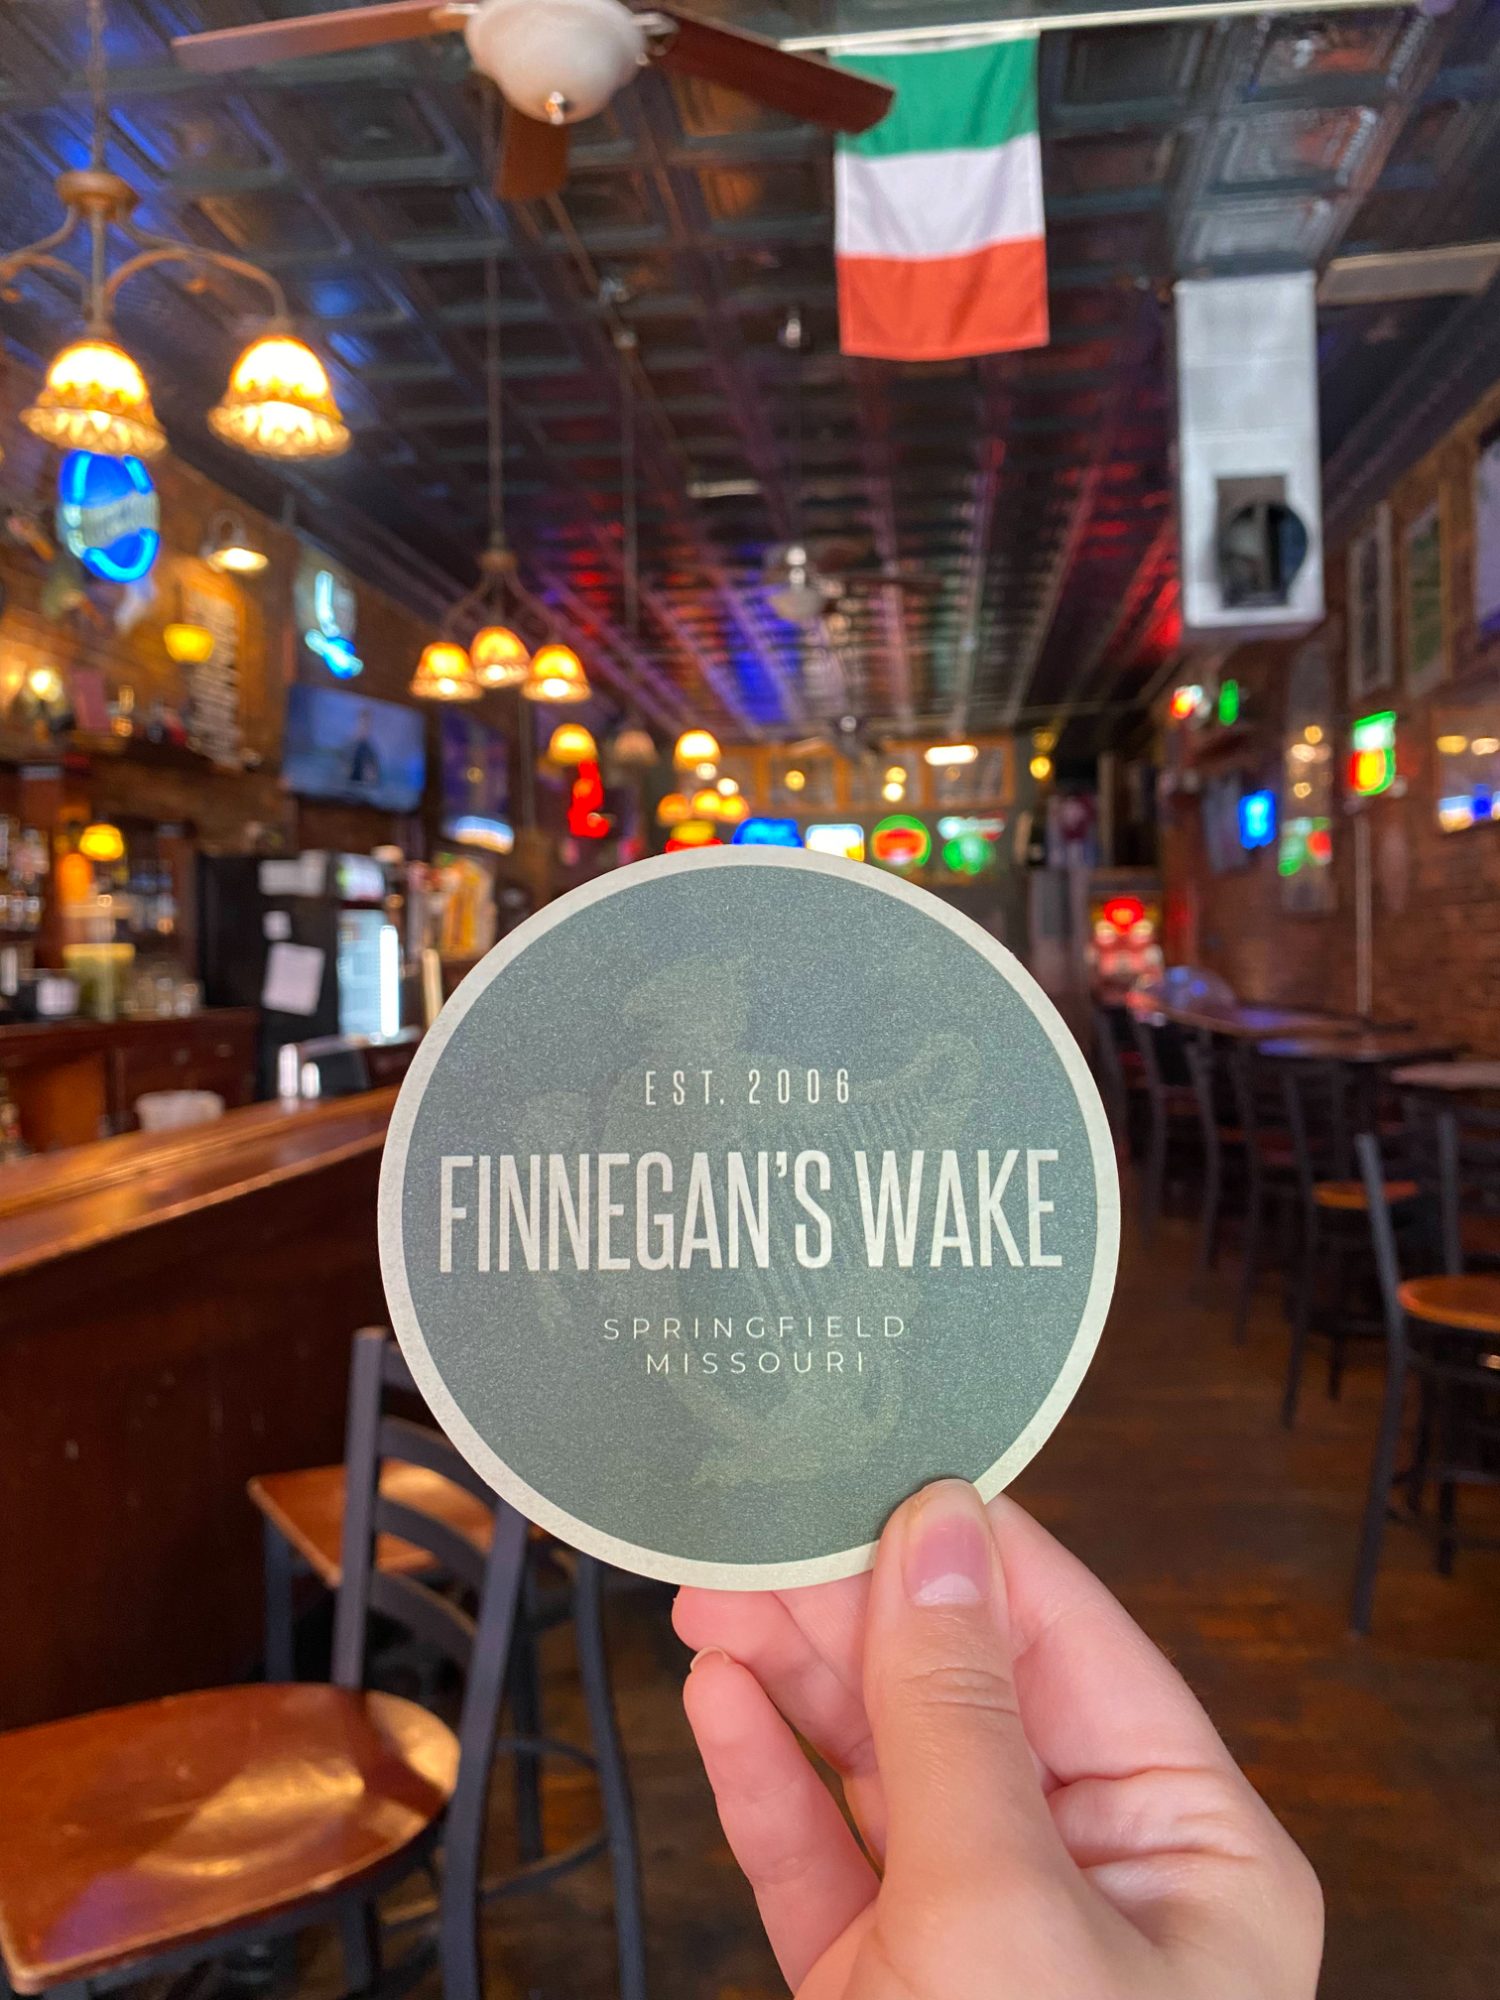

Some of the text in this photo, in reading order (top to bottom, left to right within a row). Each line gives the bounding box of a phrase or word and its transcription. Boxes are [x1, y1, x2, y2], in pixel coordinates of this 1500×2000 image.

[645, 1068, 851, 1106] EST. 2006
[439, 1148, 1063, 1273] FINNEGAN'S WAKE
[603, 1315, 906, 1341] SPRINGFIELD
[647, 1350, 865, 1375] MISSOURI
